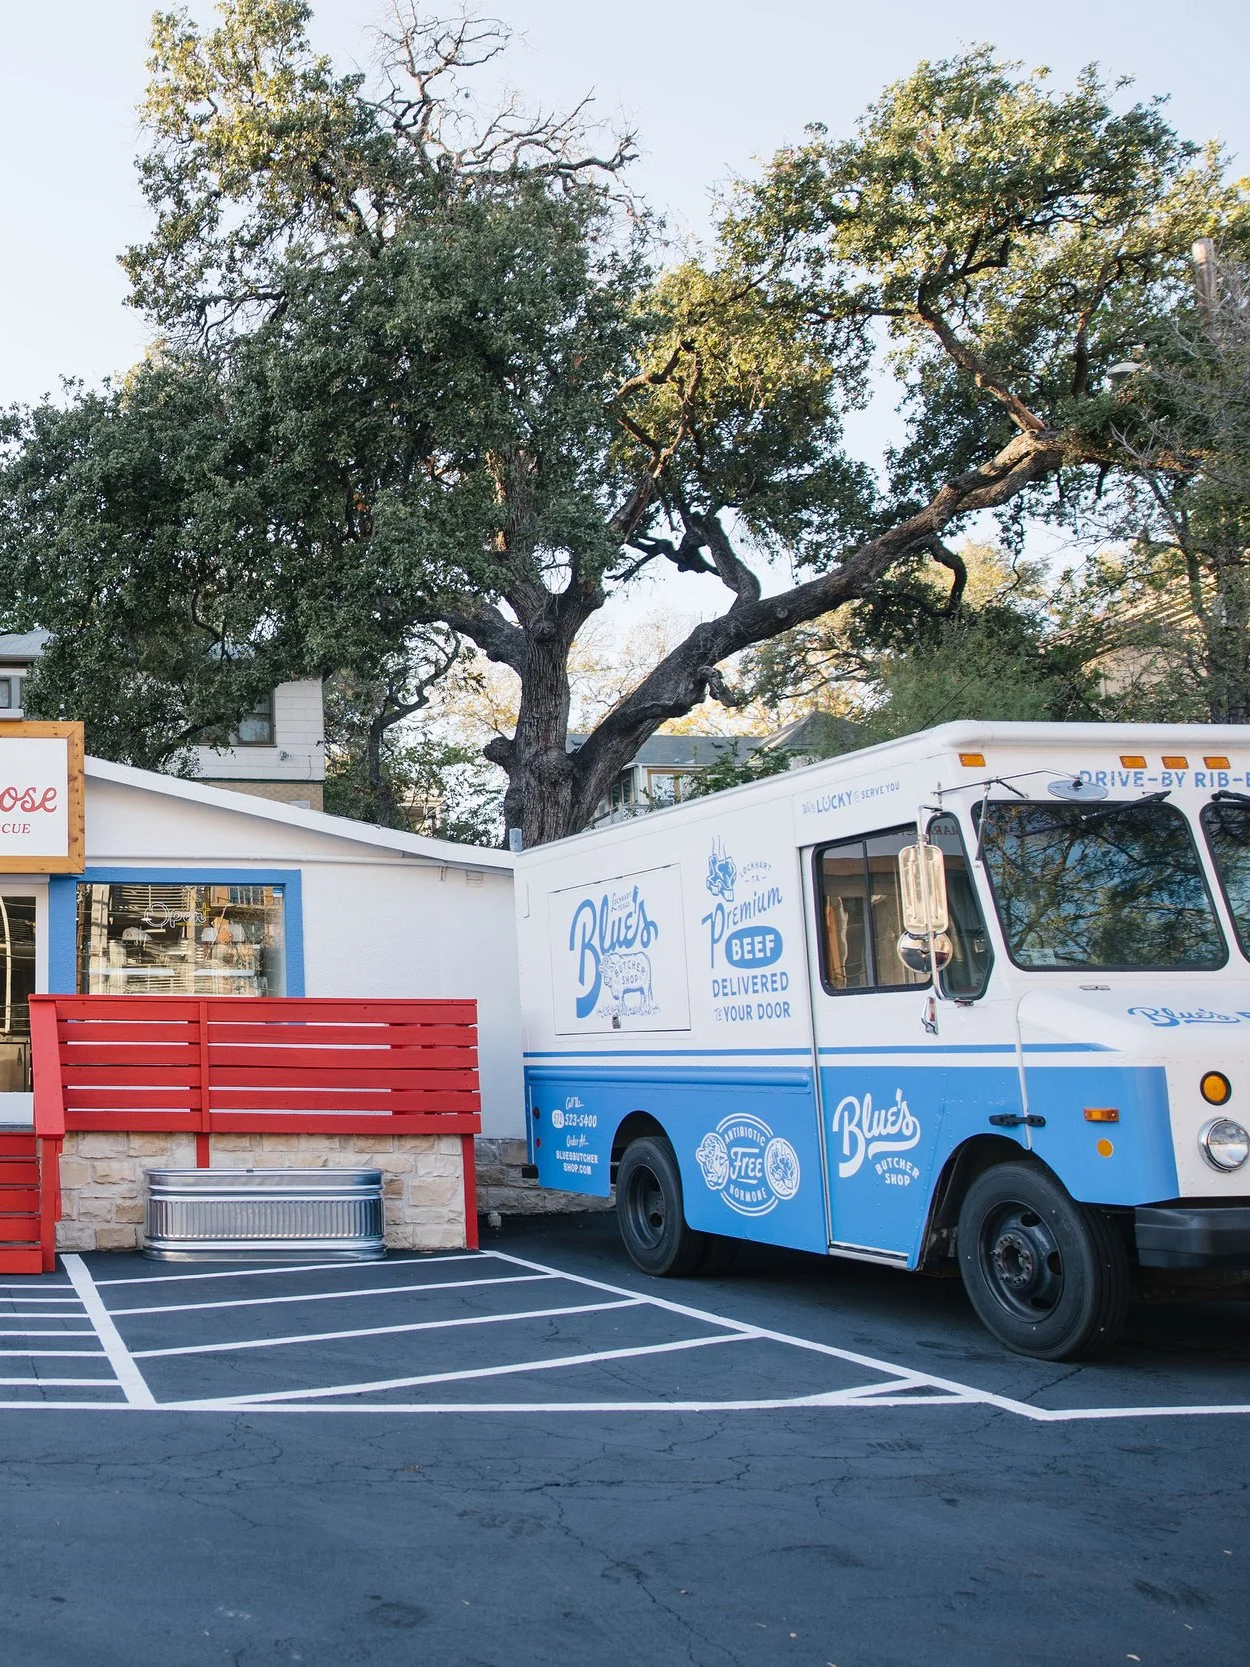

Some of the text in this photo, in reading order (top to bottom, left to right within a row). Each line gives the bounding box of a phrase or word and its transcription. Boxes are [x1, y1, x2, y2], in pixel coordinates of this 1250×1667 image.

[1079, 770, 1186, 788] DRIVE-BY
[816, 790, 852, 813] LUCKY
[861, 785, 884, 799] SERVE
[886, 781, 900, 793] YOU
[739, 860, 772, 878] LOCKHART
[143, 901, 207, 928] Open
[701, 886, 783, 969] Premium
[569, 885, 659, 1019] Blue's
[731, 933, 775, 961] BEEF
[614, 960, 646, 978] BUTCHER
[621, 974, 639, 985] SHOP
[712, 971, 789, 998] DELIVERED
[723, 1004, 753, 1022] YOUR
[757, 1001, 791, 1020] DOOR
[1127, 1006, 1241, 1027] Blue's
[564, 1113, 598, 1128] 523-5400
[724, 1126, 766, 1147] ANTIBIOTIC
[832, 1087, 921, 1178] Blue's
[555, 1150, 598, 1164] BLUESBUTCHER
[563, 1162, 592, 1175] SHOP.COM
[874, 1157, 920, 1179] BUTCHER
[884, 1173, 910, 1186] SHOP
[729, 1184, 767, 1202] HORMONE
